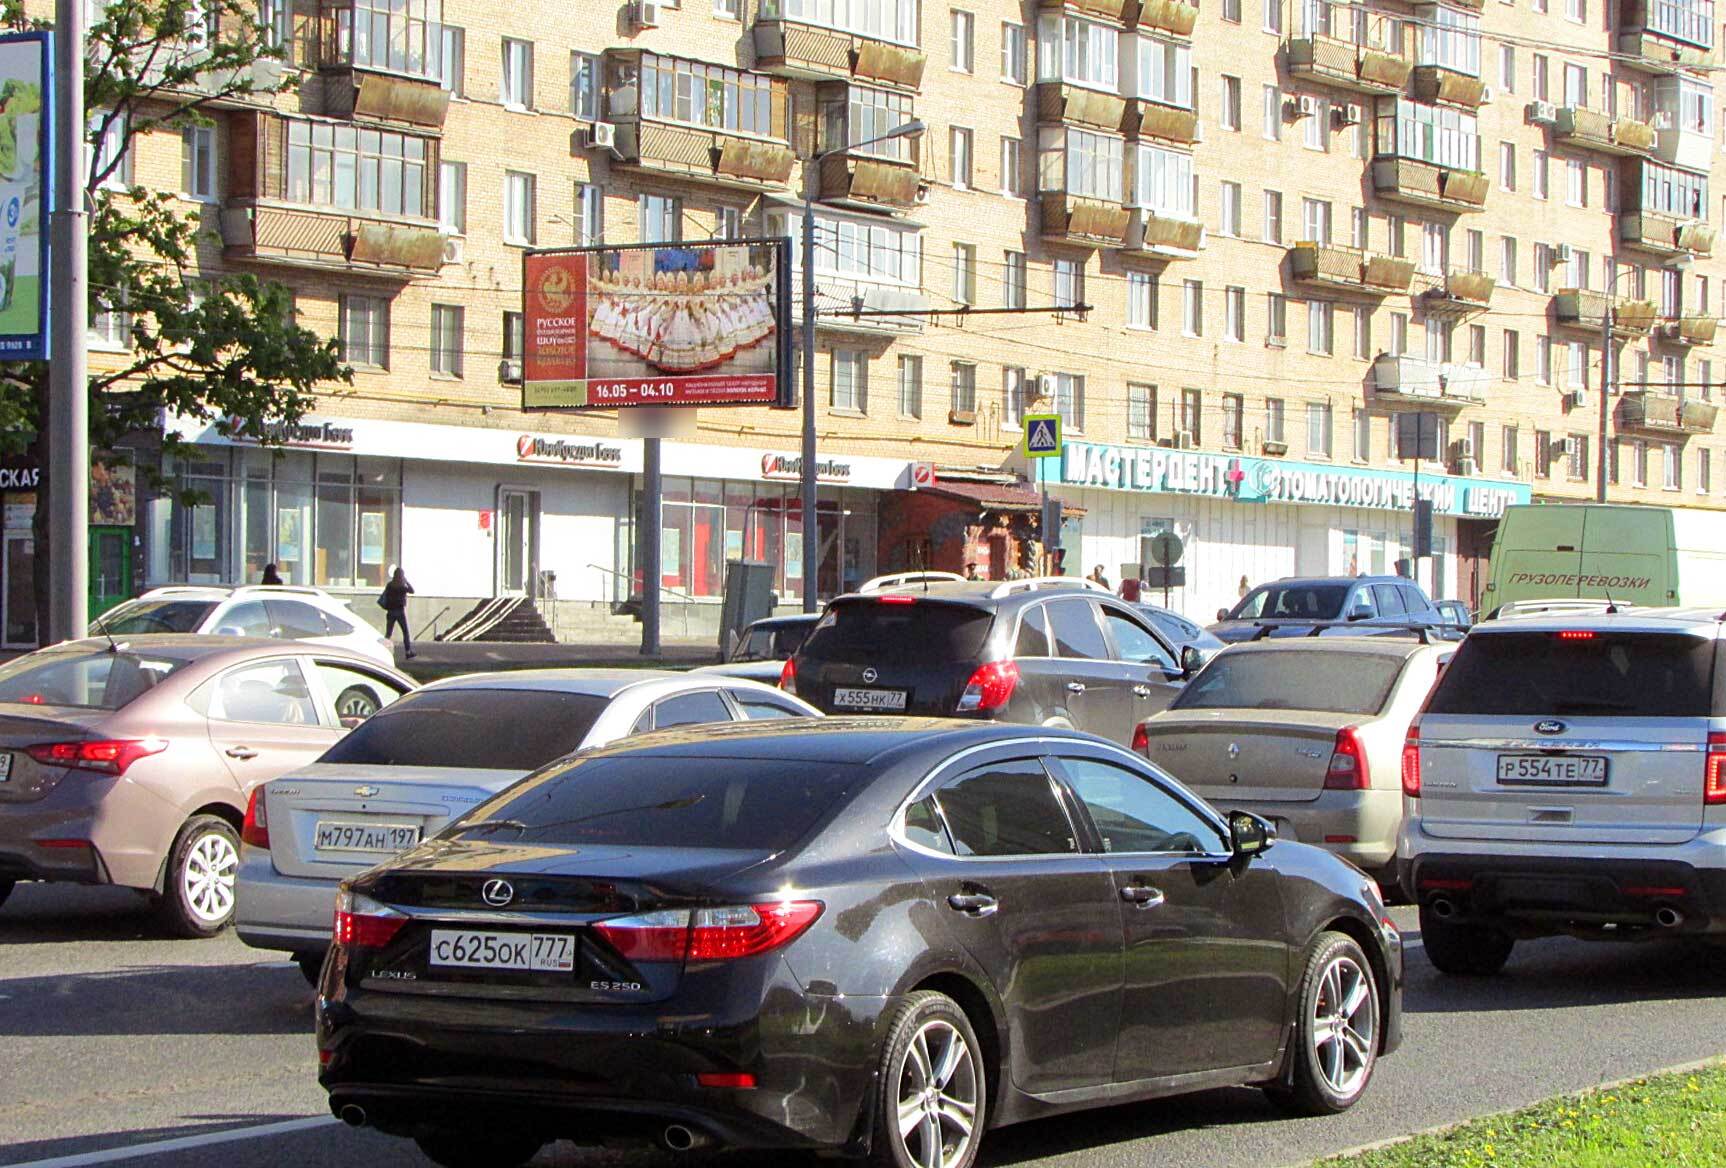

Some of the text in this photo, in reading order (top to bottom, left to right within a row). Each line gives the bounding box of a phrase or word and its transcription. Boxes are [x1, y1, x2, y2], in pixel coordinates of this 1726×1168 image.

[537, 317, 576, 328] РУССКОЕ
[597, 384, 627, 398] 16.05
[641, 383, 674, 397] 04.10
[1065, 443, 1231, 496] МАСТЕРДЕНТ
[1465, 486, 1517, 517] ЦЕНТР
[1508, 572, 1651, 590] ГРУЗОПЕРЕВОЗКИ
[533, 936, 569, 958] 777
[372, 969, 417, 980] LEXUS
[590, 981, 610, 990] ES
